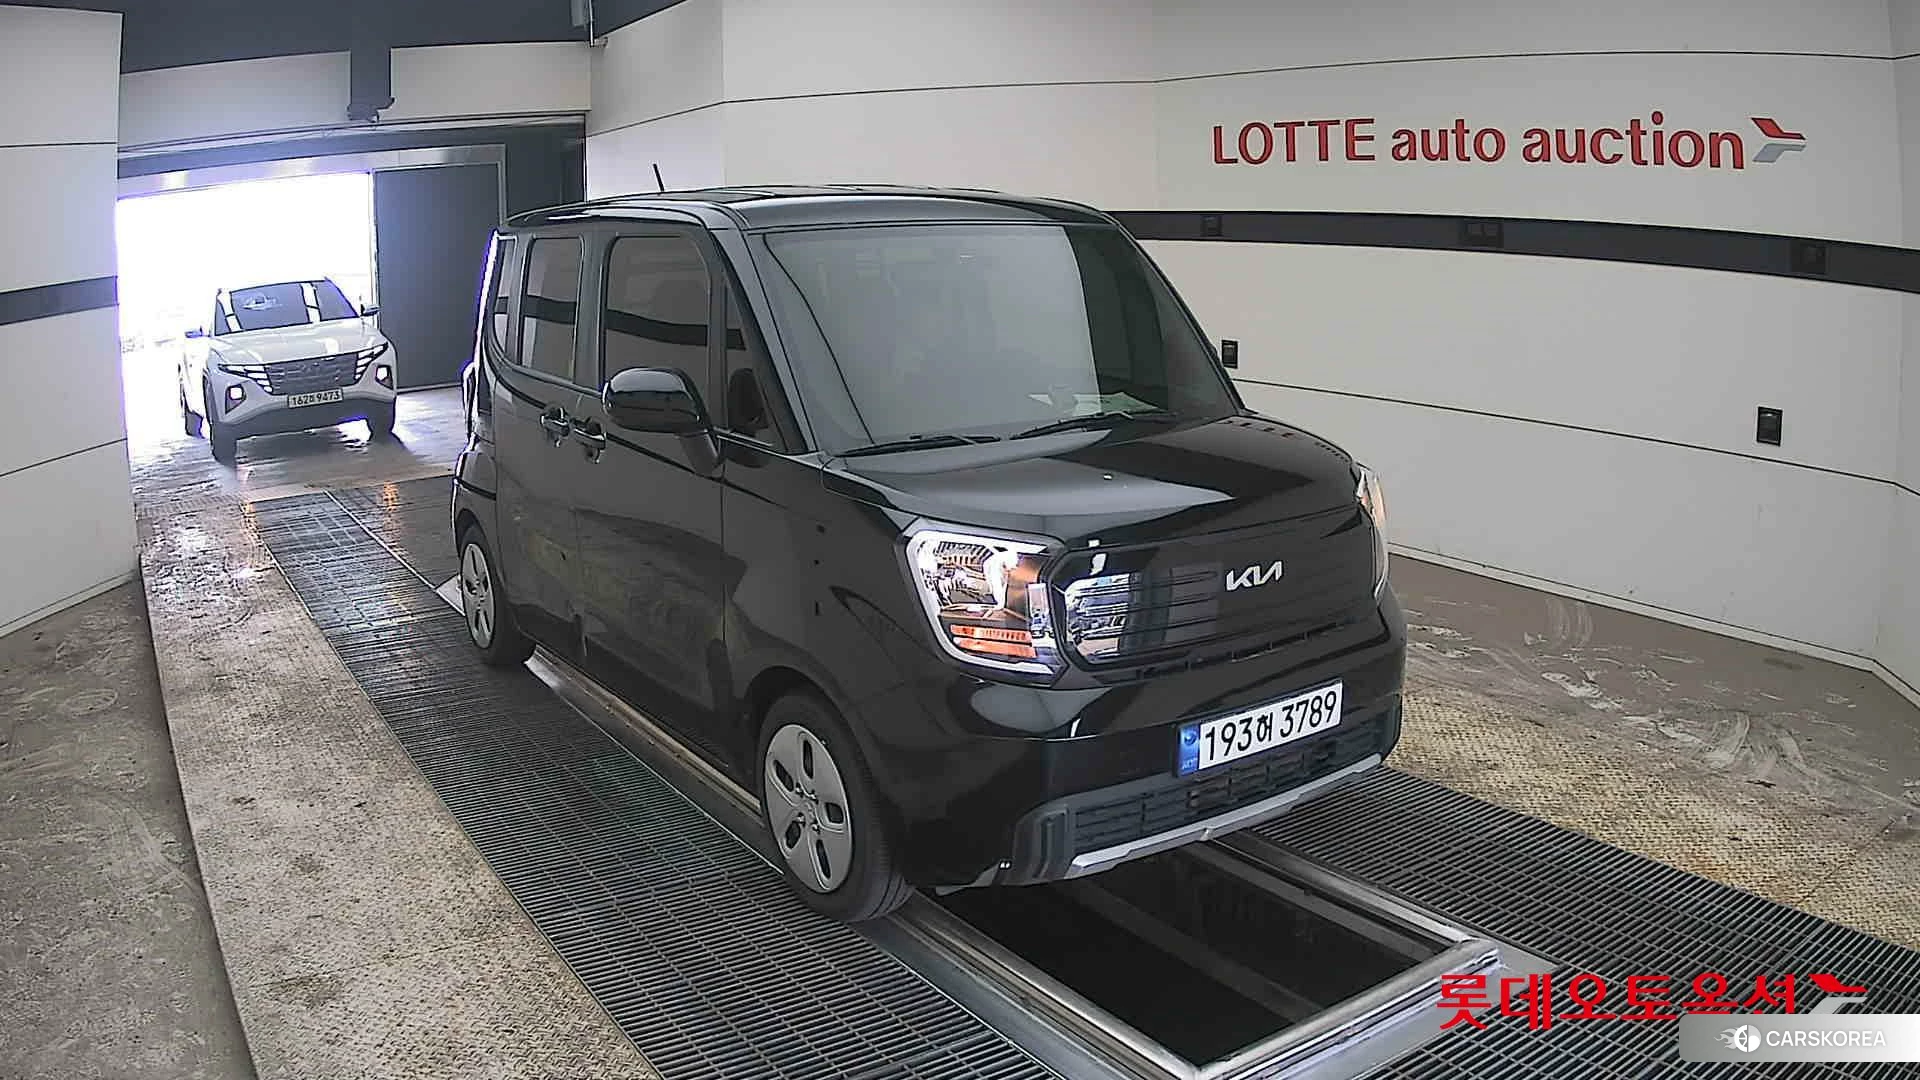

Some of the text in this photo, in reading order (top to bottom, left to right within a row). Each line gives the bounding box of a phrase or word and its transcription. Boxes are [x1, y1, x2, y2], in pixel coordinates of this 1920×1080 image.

[1213, 111, 1745, 170] LOTTE auto auction
[1226, 560, 1283, 591] KIA
[1205, 690, 1337, 761] 193허 3789
